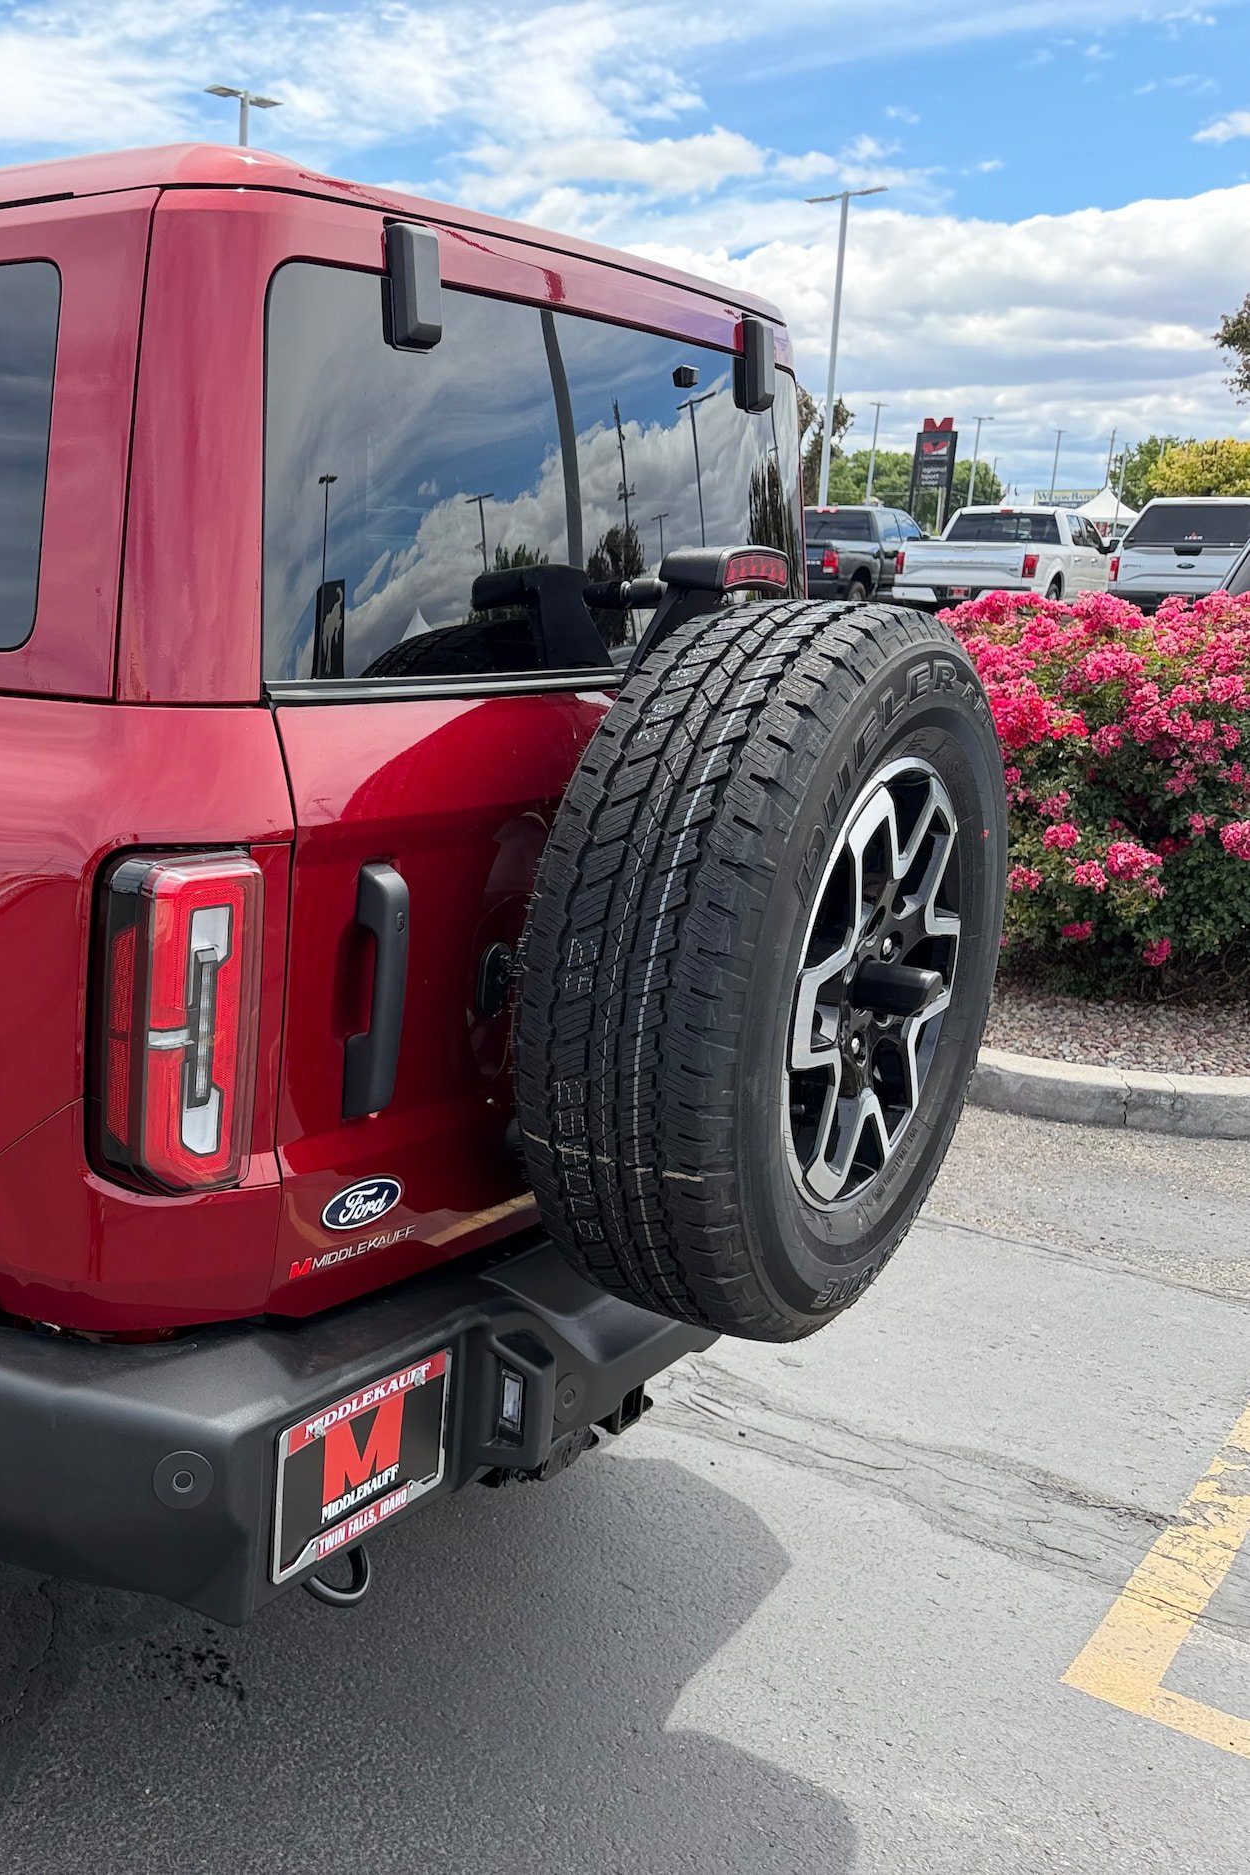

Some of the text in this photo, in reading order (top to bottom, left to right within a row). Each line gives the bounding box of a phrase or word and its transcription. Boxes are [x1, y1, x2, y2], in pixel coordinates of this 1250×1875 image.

[311, 1224, 416, 1271] MIDDLEKAUFF
[318, 1486, 408, 1555] TWIN FALLS, IDAHO
[321, 1463, 400, 1525] MIDDLEKAUFF
